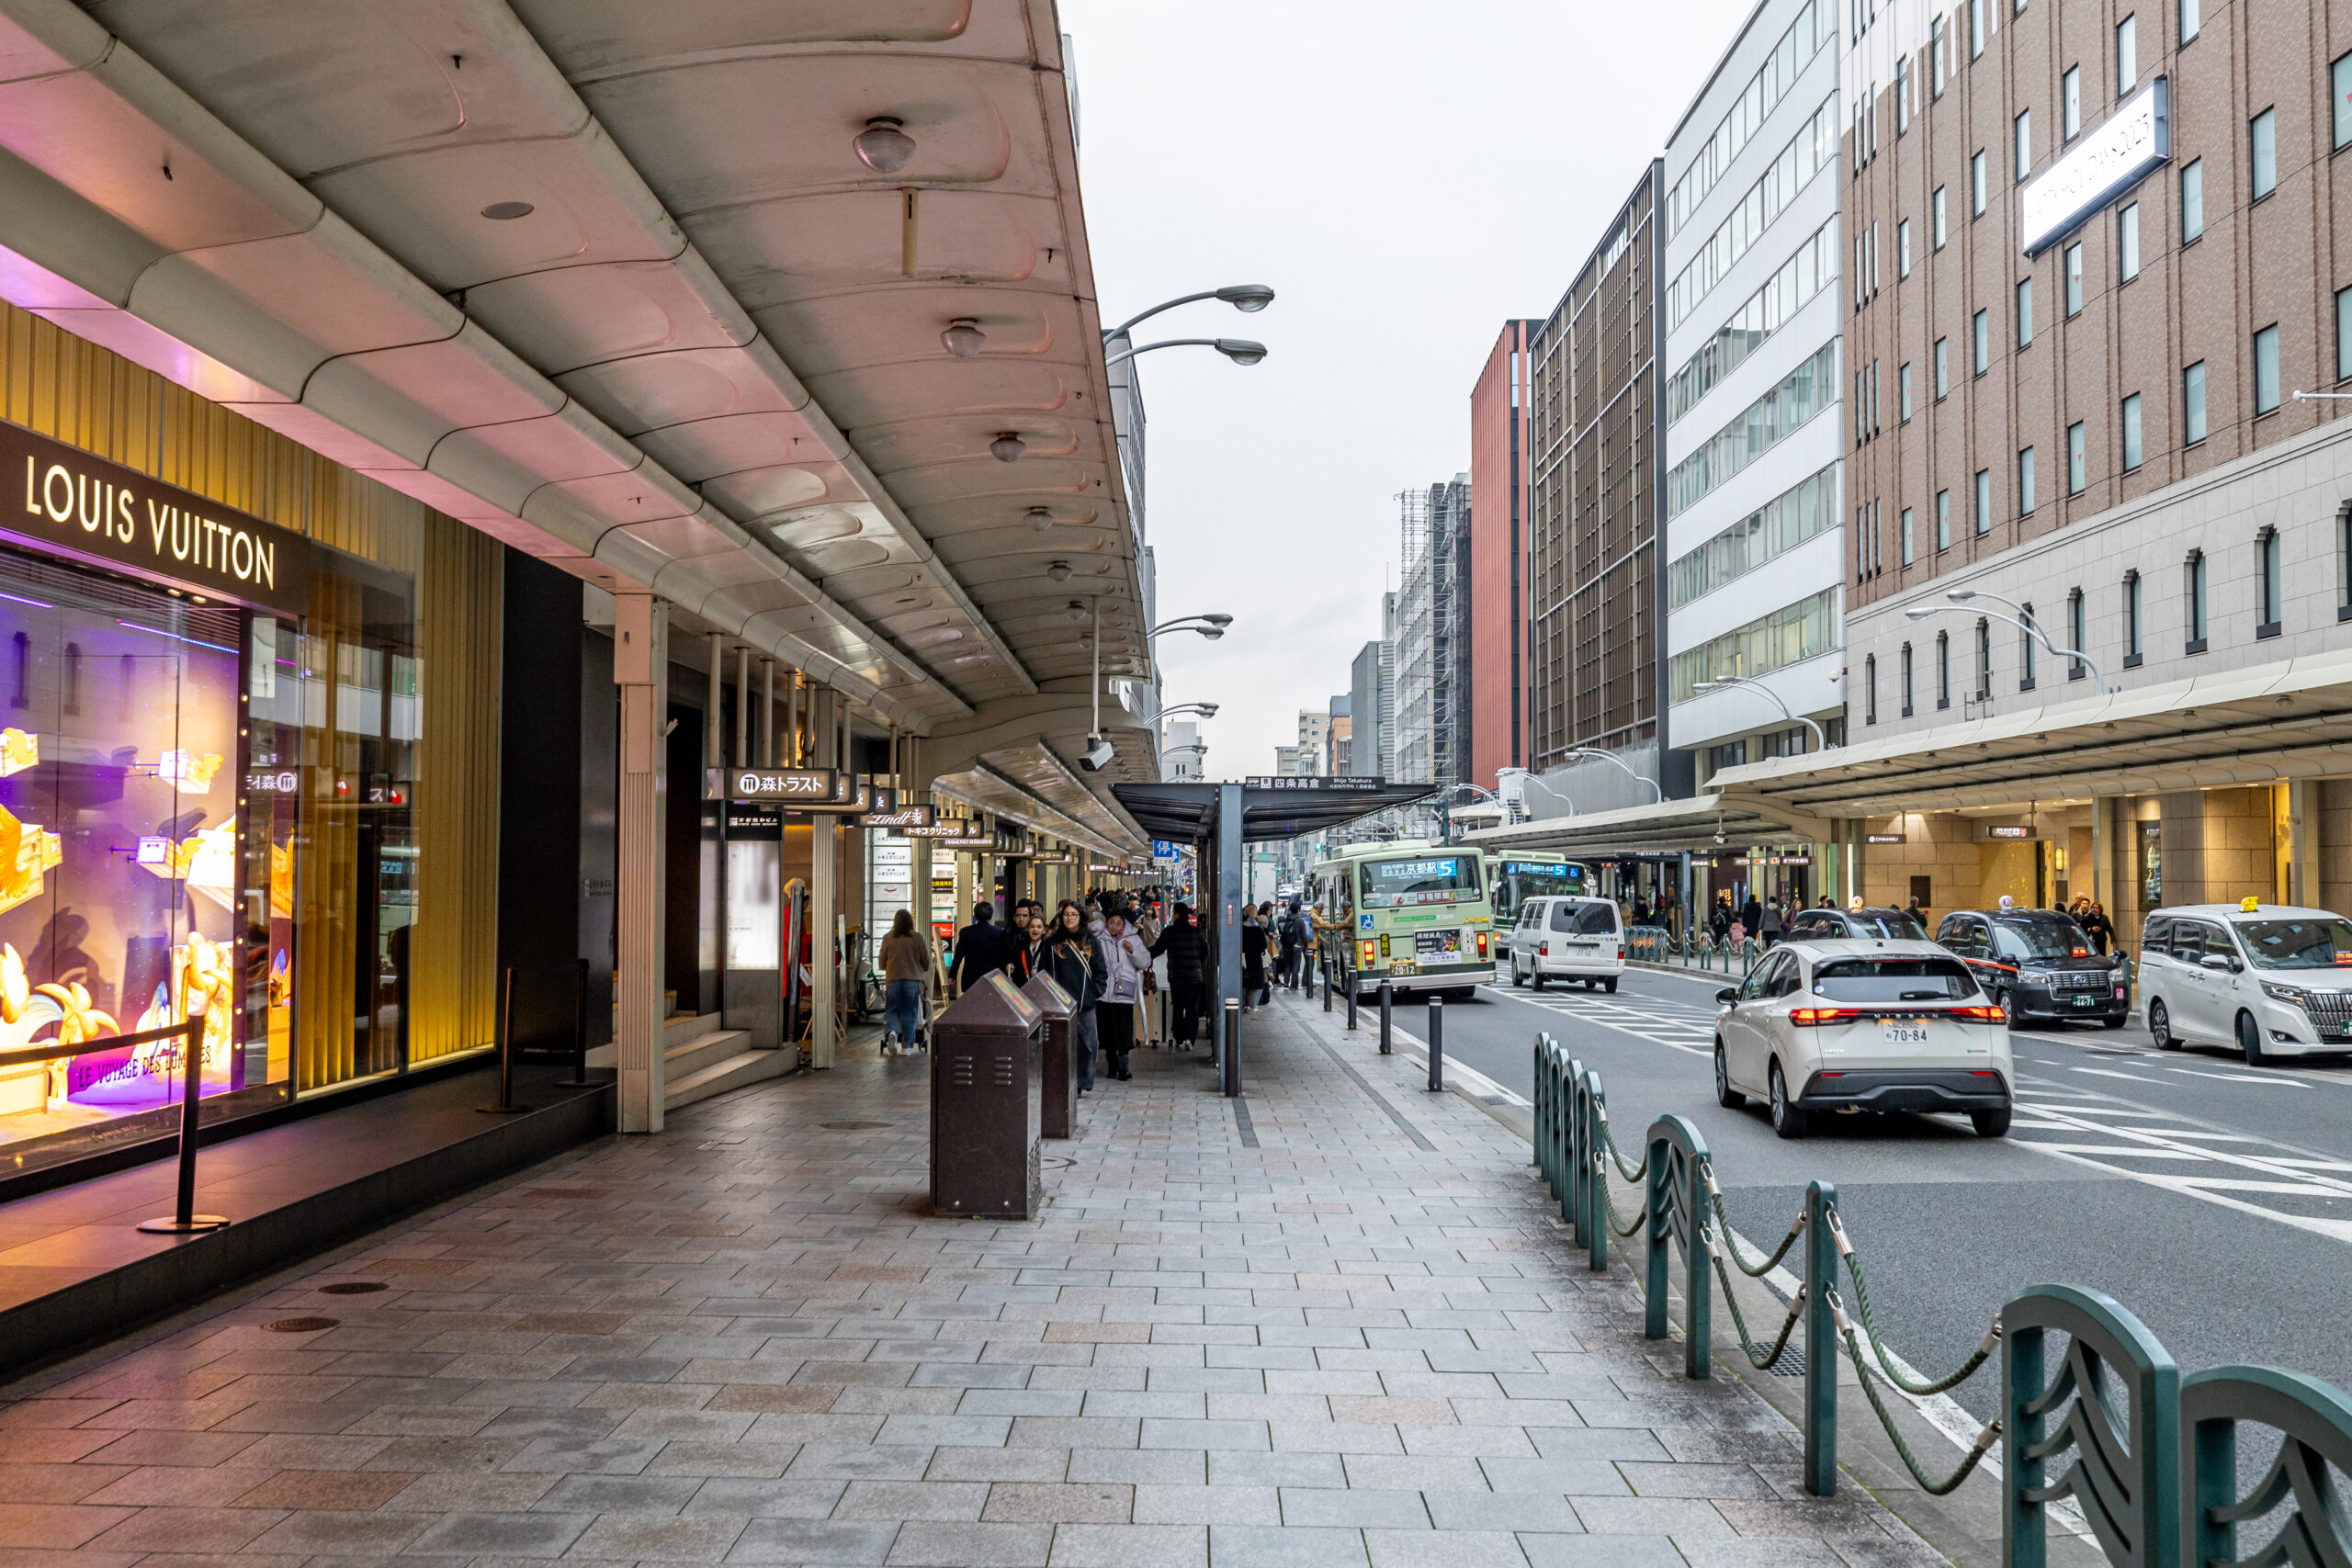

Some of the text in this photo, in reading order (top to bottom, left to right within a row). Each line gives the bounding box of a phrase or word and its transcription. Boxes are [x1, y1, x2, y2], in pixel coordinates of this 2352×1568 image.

[27, 456, 274, 591] LOUIS VUITTON
[760, 775, 822, 793] 森トラスト
[1275, 778, 1319, 789] 四条高倉
[867, 811, 911, 825] Lindt
[908, 827, 959, 835] トキコ クリニック
[1157, 840, 1170, 854] 停
[1406, 862, 1437, 874] 京都駅
[1441, 861, 1453, 875] 5
[1555, 865, 1563, 874] 5
[1394, 965, 1415, 975] 20-12
[2077, 998, 2095, 1007] 66-71
[1893, 1029, 1927, 1042] 70-84
[79, 1066, 91, 1088] LE
[97, 1058, 139, 1084] VOYAGE
[142, 1055, 162, 1076] DES
